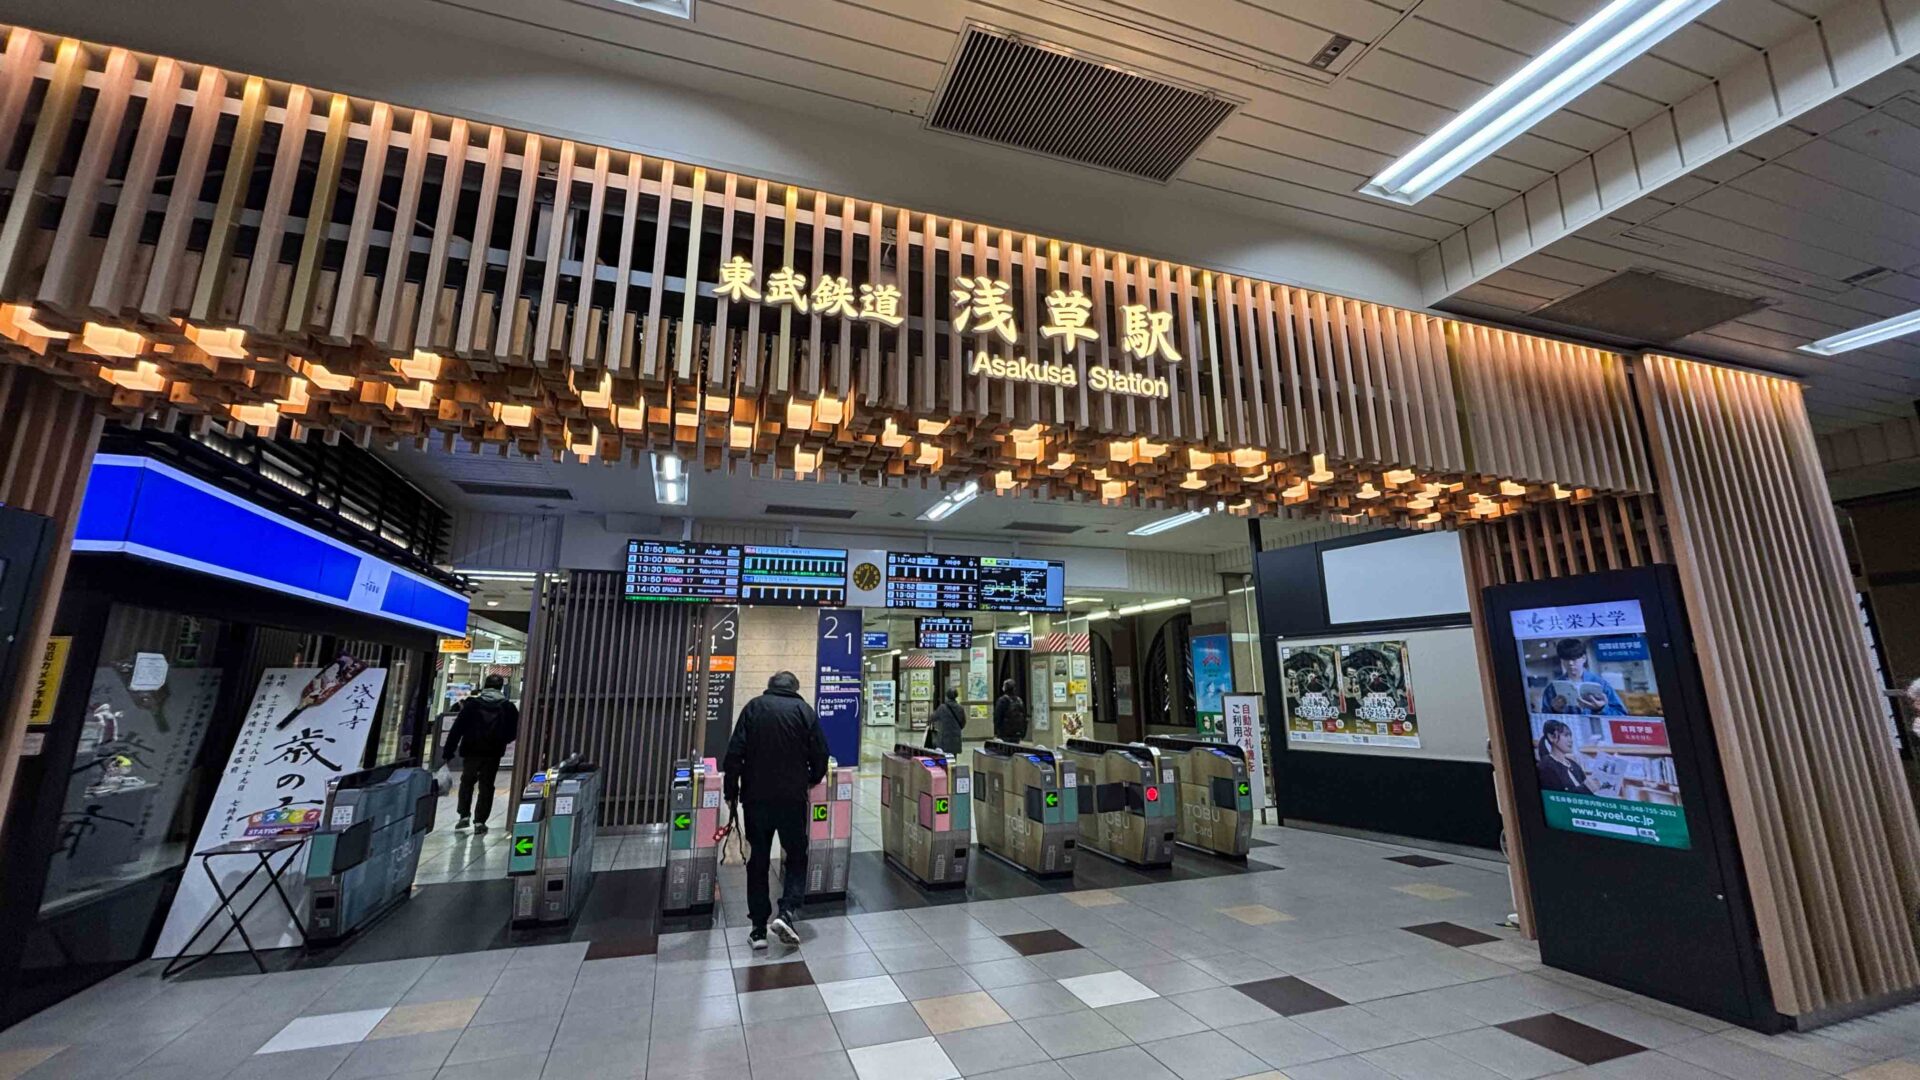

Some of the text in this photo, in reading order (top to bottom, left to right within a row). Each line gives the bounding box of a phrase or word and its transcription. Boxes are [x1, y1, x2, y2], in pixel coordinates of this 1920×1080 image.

[713, 256, 1183, 362] 東武鉄道 浅草駅
[970, 351, 1169, 399] Asakusa Station
[722, 620, 736, 640] 3
[823, 616, 839, 639] 2
[1549, 610, 1627, 631] 共栄大学
[464, 639, 472, 650] 3
[845, 632, 853, 655] 1
[1023, 633, 1030, 645] 1
[338, 684, 376, 730] 浅草寺
[813, 805, 827, 819] IC
[935, 800, 948, 812] IC
[1183, 803, 1220, 823] TOBU
[1570, 807, 1655, 826] www.kyoei.ac.jp
